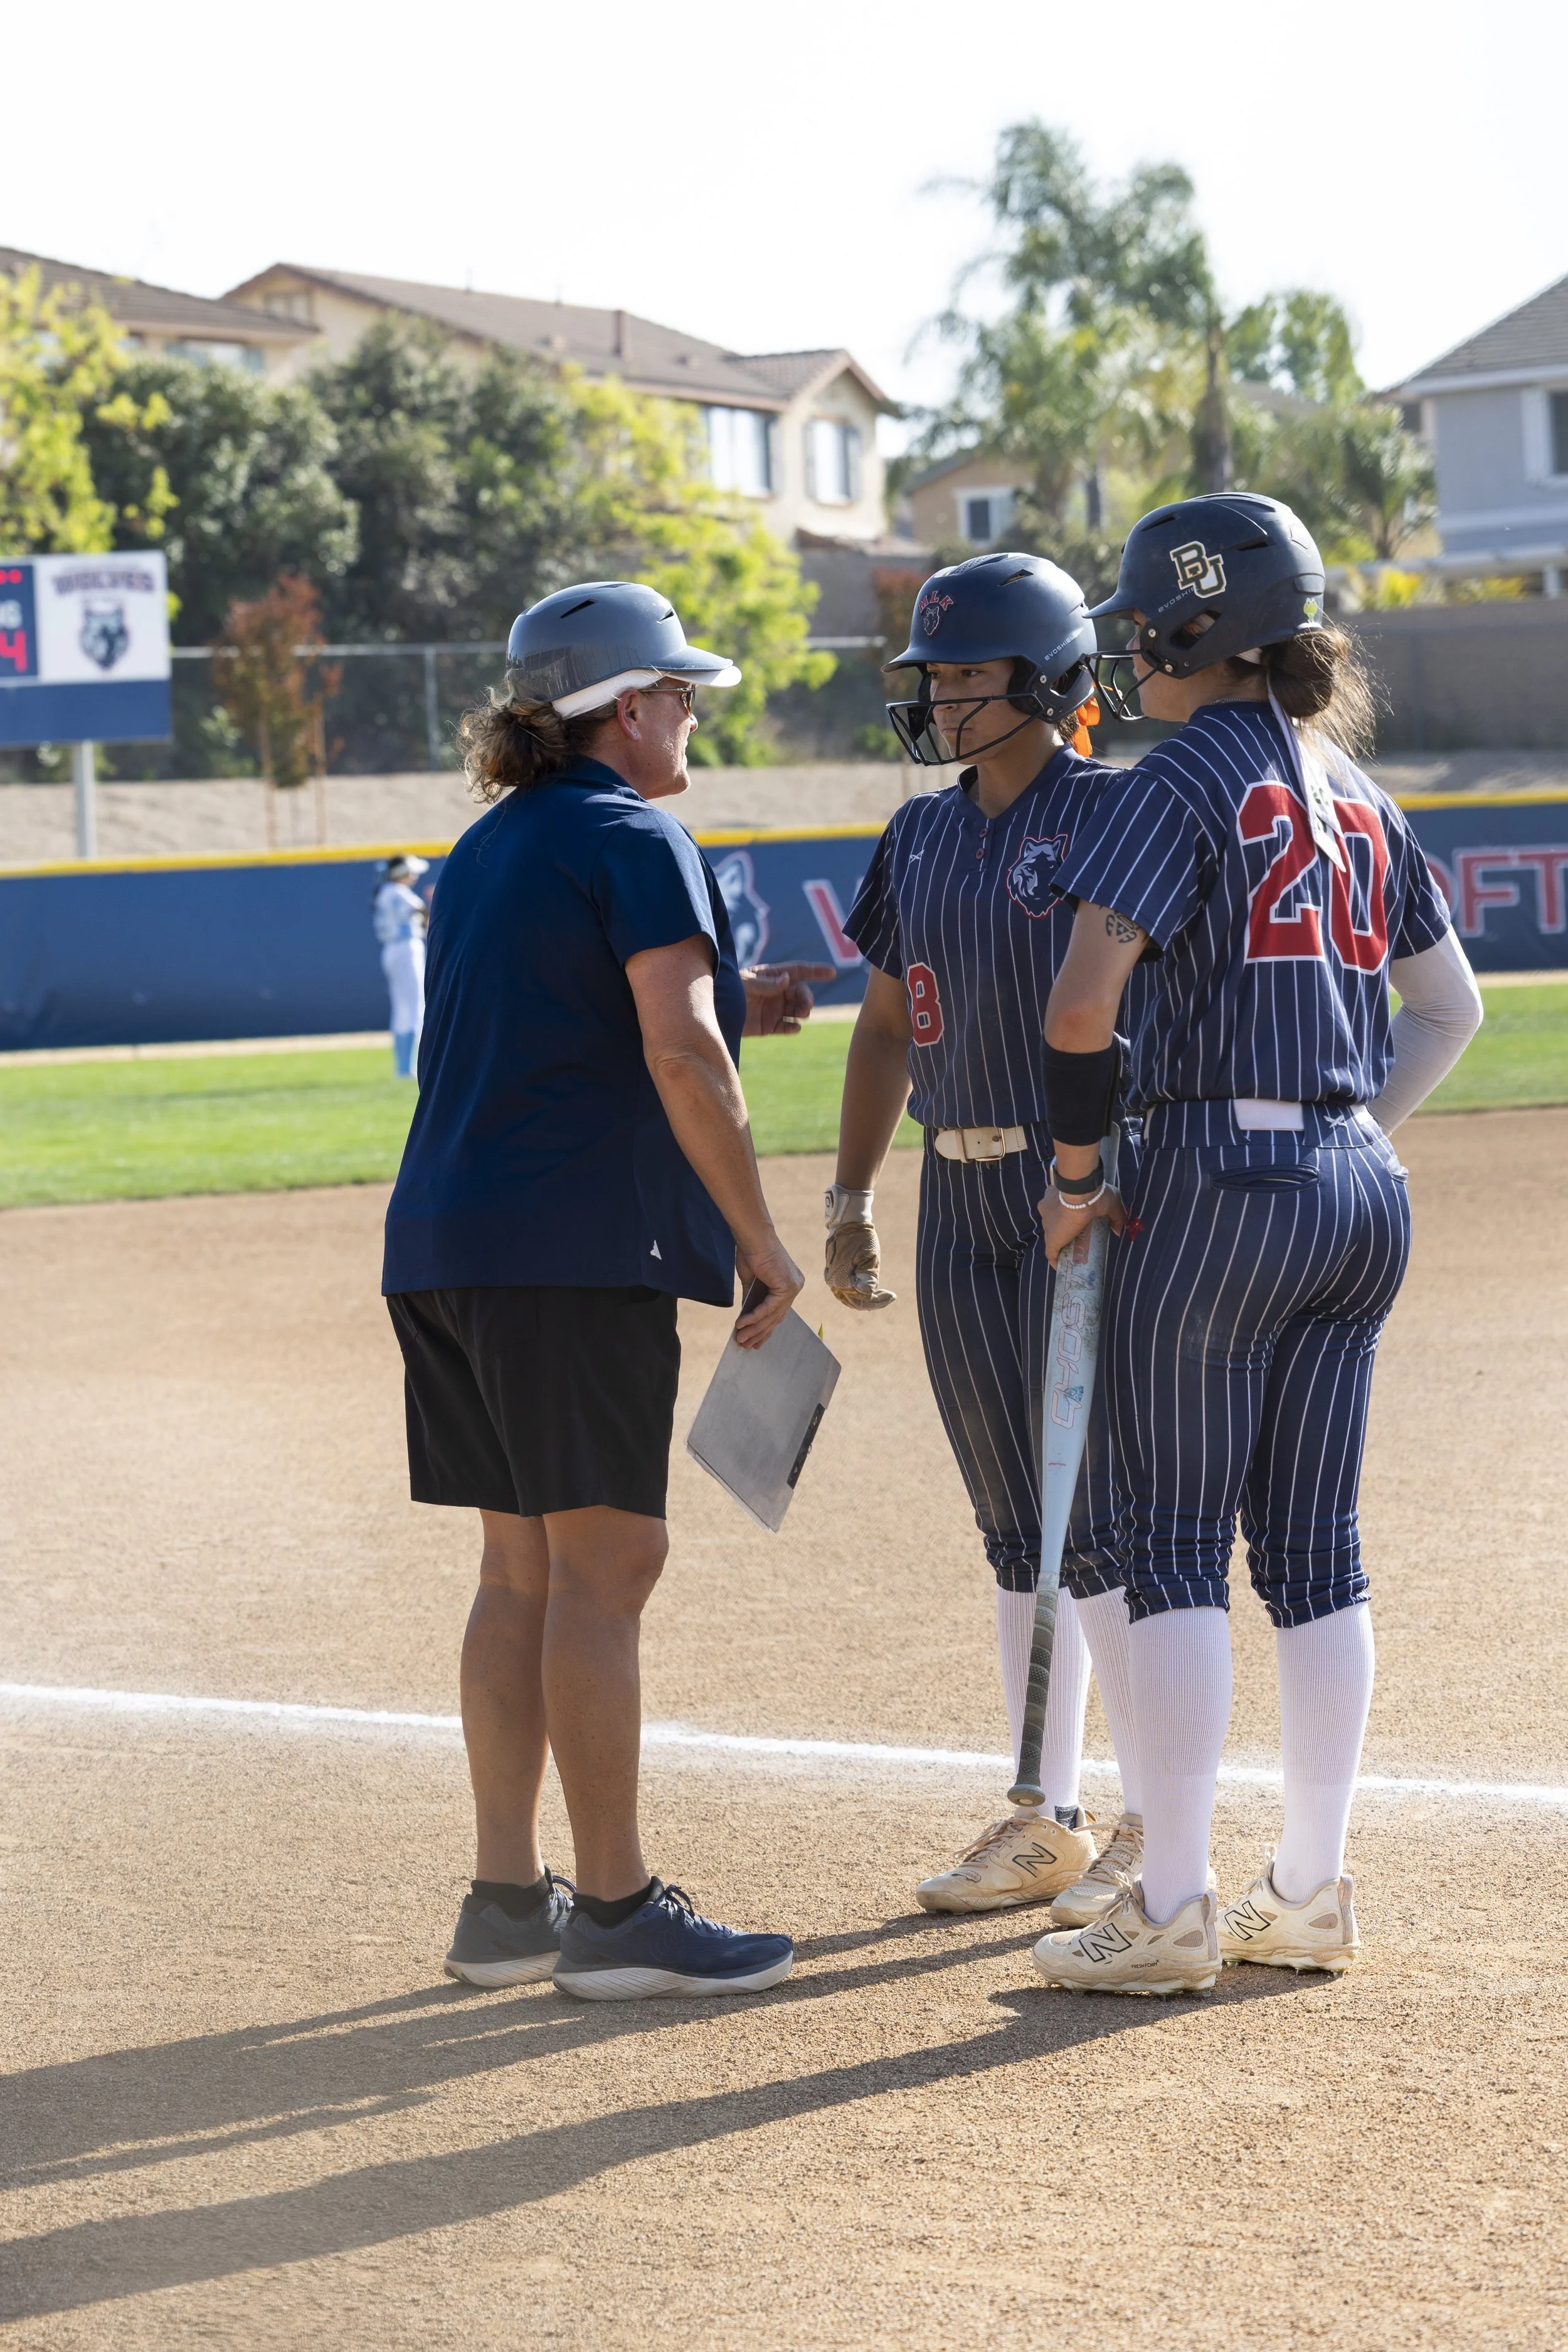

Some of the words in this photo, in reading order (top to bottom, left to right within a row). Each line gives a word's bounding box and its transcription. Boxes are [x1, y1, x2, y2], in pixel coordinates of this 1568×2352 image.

[918, 591, 953, 613] MLK
[1170, 541, 1226, 598] BU
[1044, 629, 1081, 660] EVOSHIEL
[1236, 780, 1390, 975] 20
[908, 961, 944, 1047] 8
[1051, 1259, 1094, 1429] GHOST
